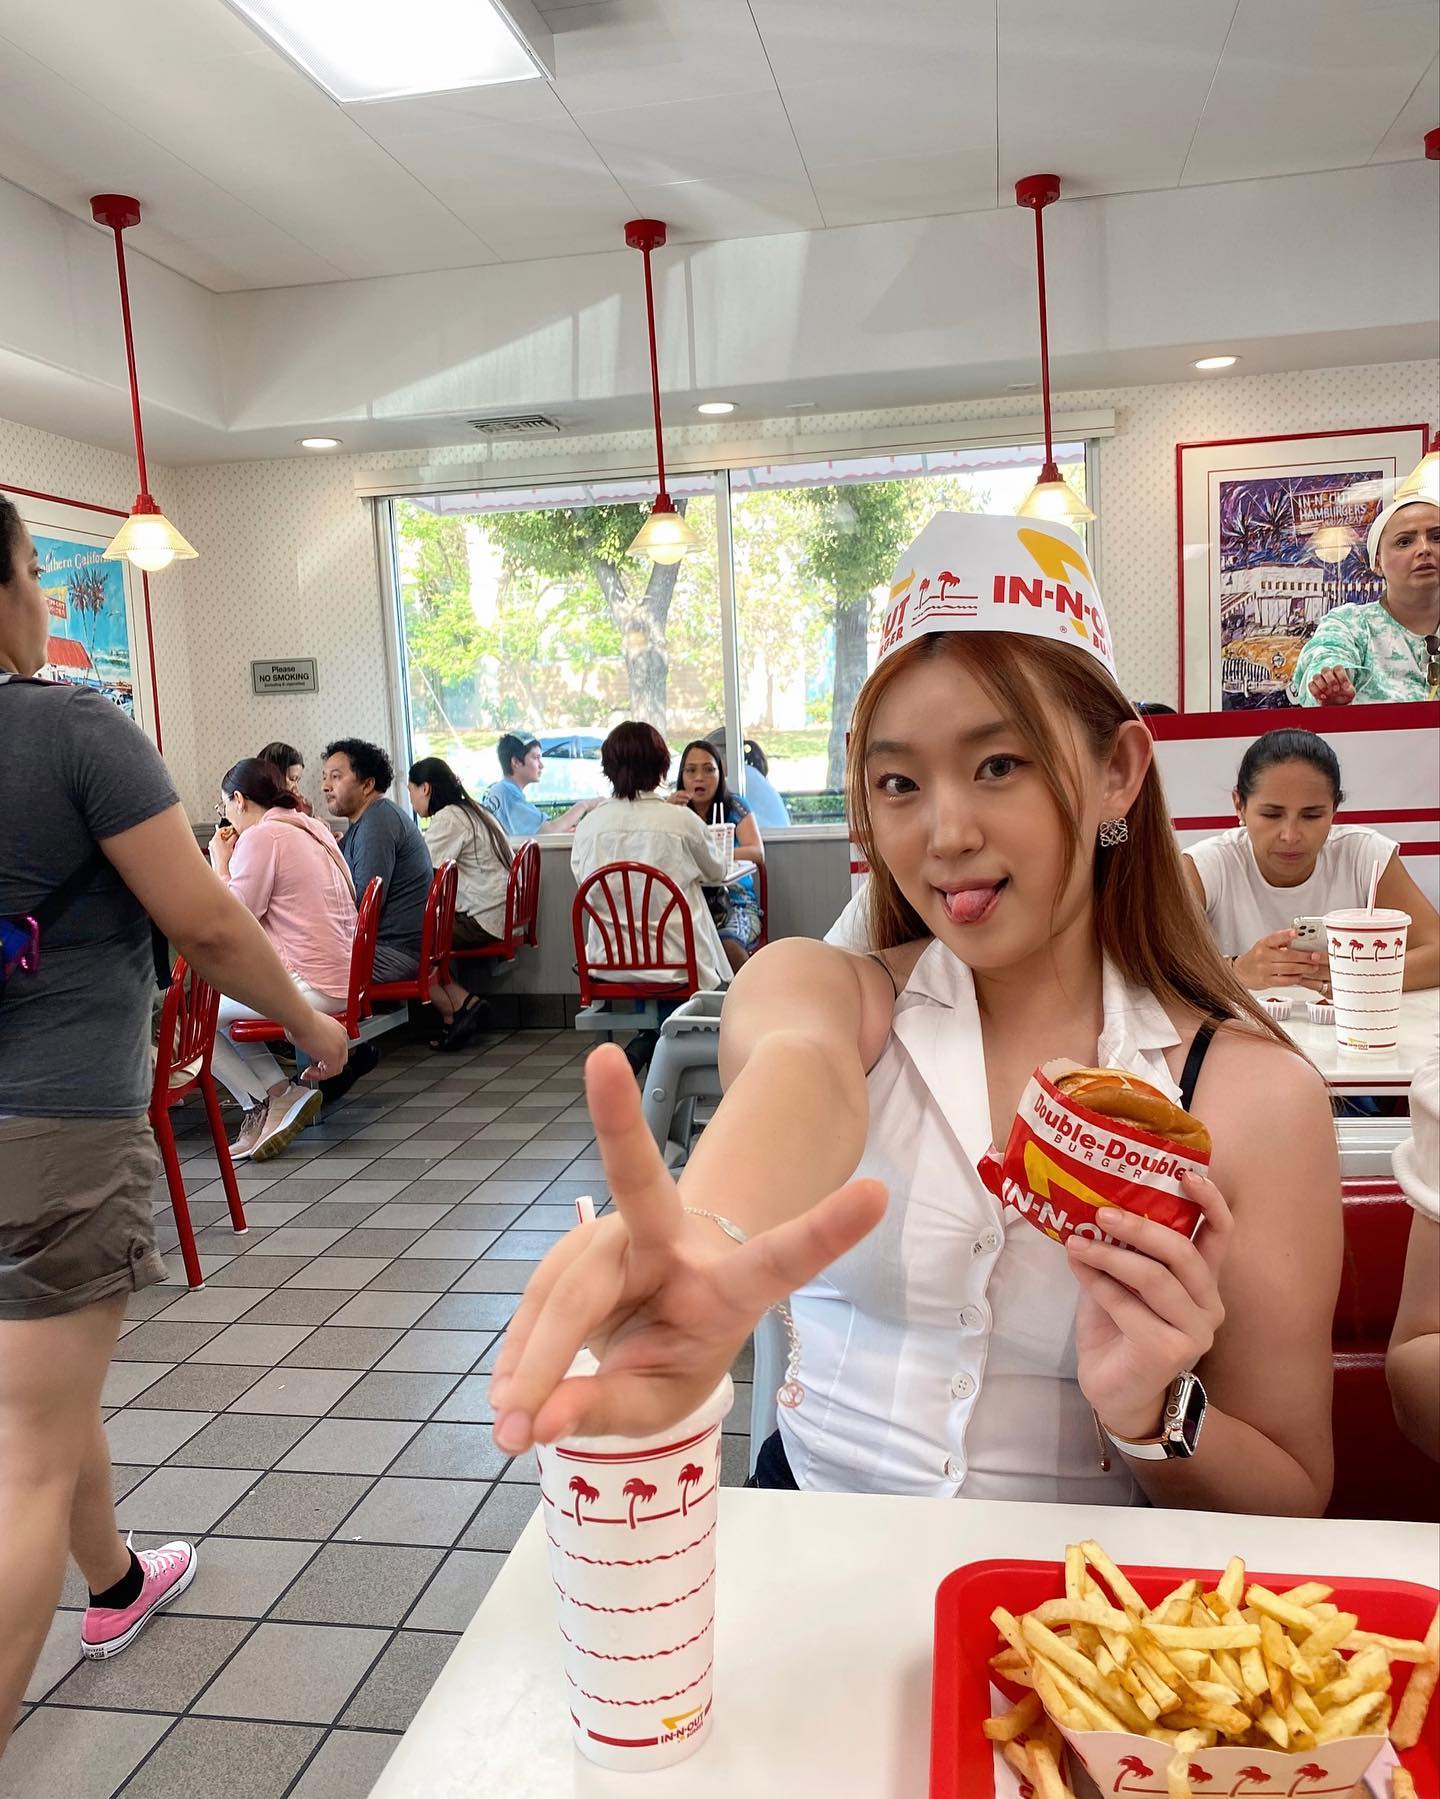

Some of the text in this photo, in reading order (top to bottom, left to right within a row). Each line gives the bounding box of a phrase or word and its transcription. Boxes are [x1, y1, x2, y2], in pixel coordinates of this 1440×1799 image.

[1299, 503, 1368, 521] HAMBURGERS
[259, 672, 310, 682] NO SMOKING
[271, 665, 296, 673] Please
[1054, 1133, 1143, 1180] BURGER
[660, 1711, 704, 1744] IN-N-OUT
